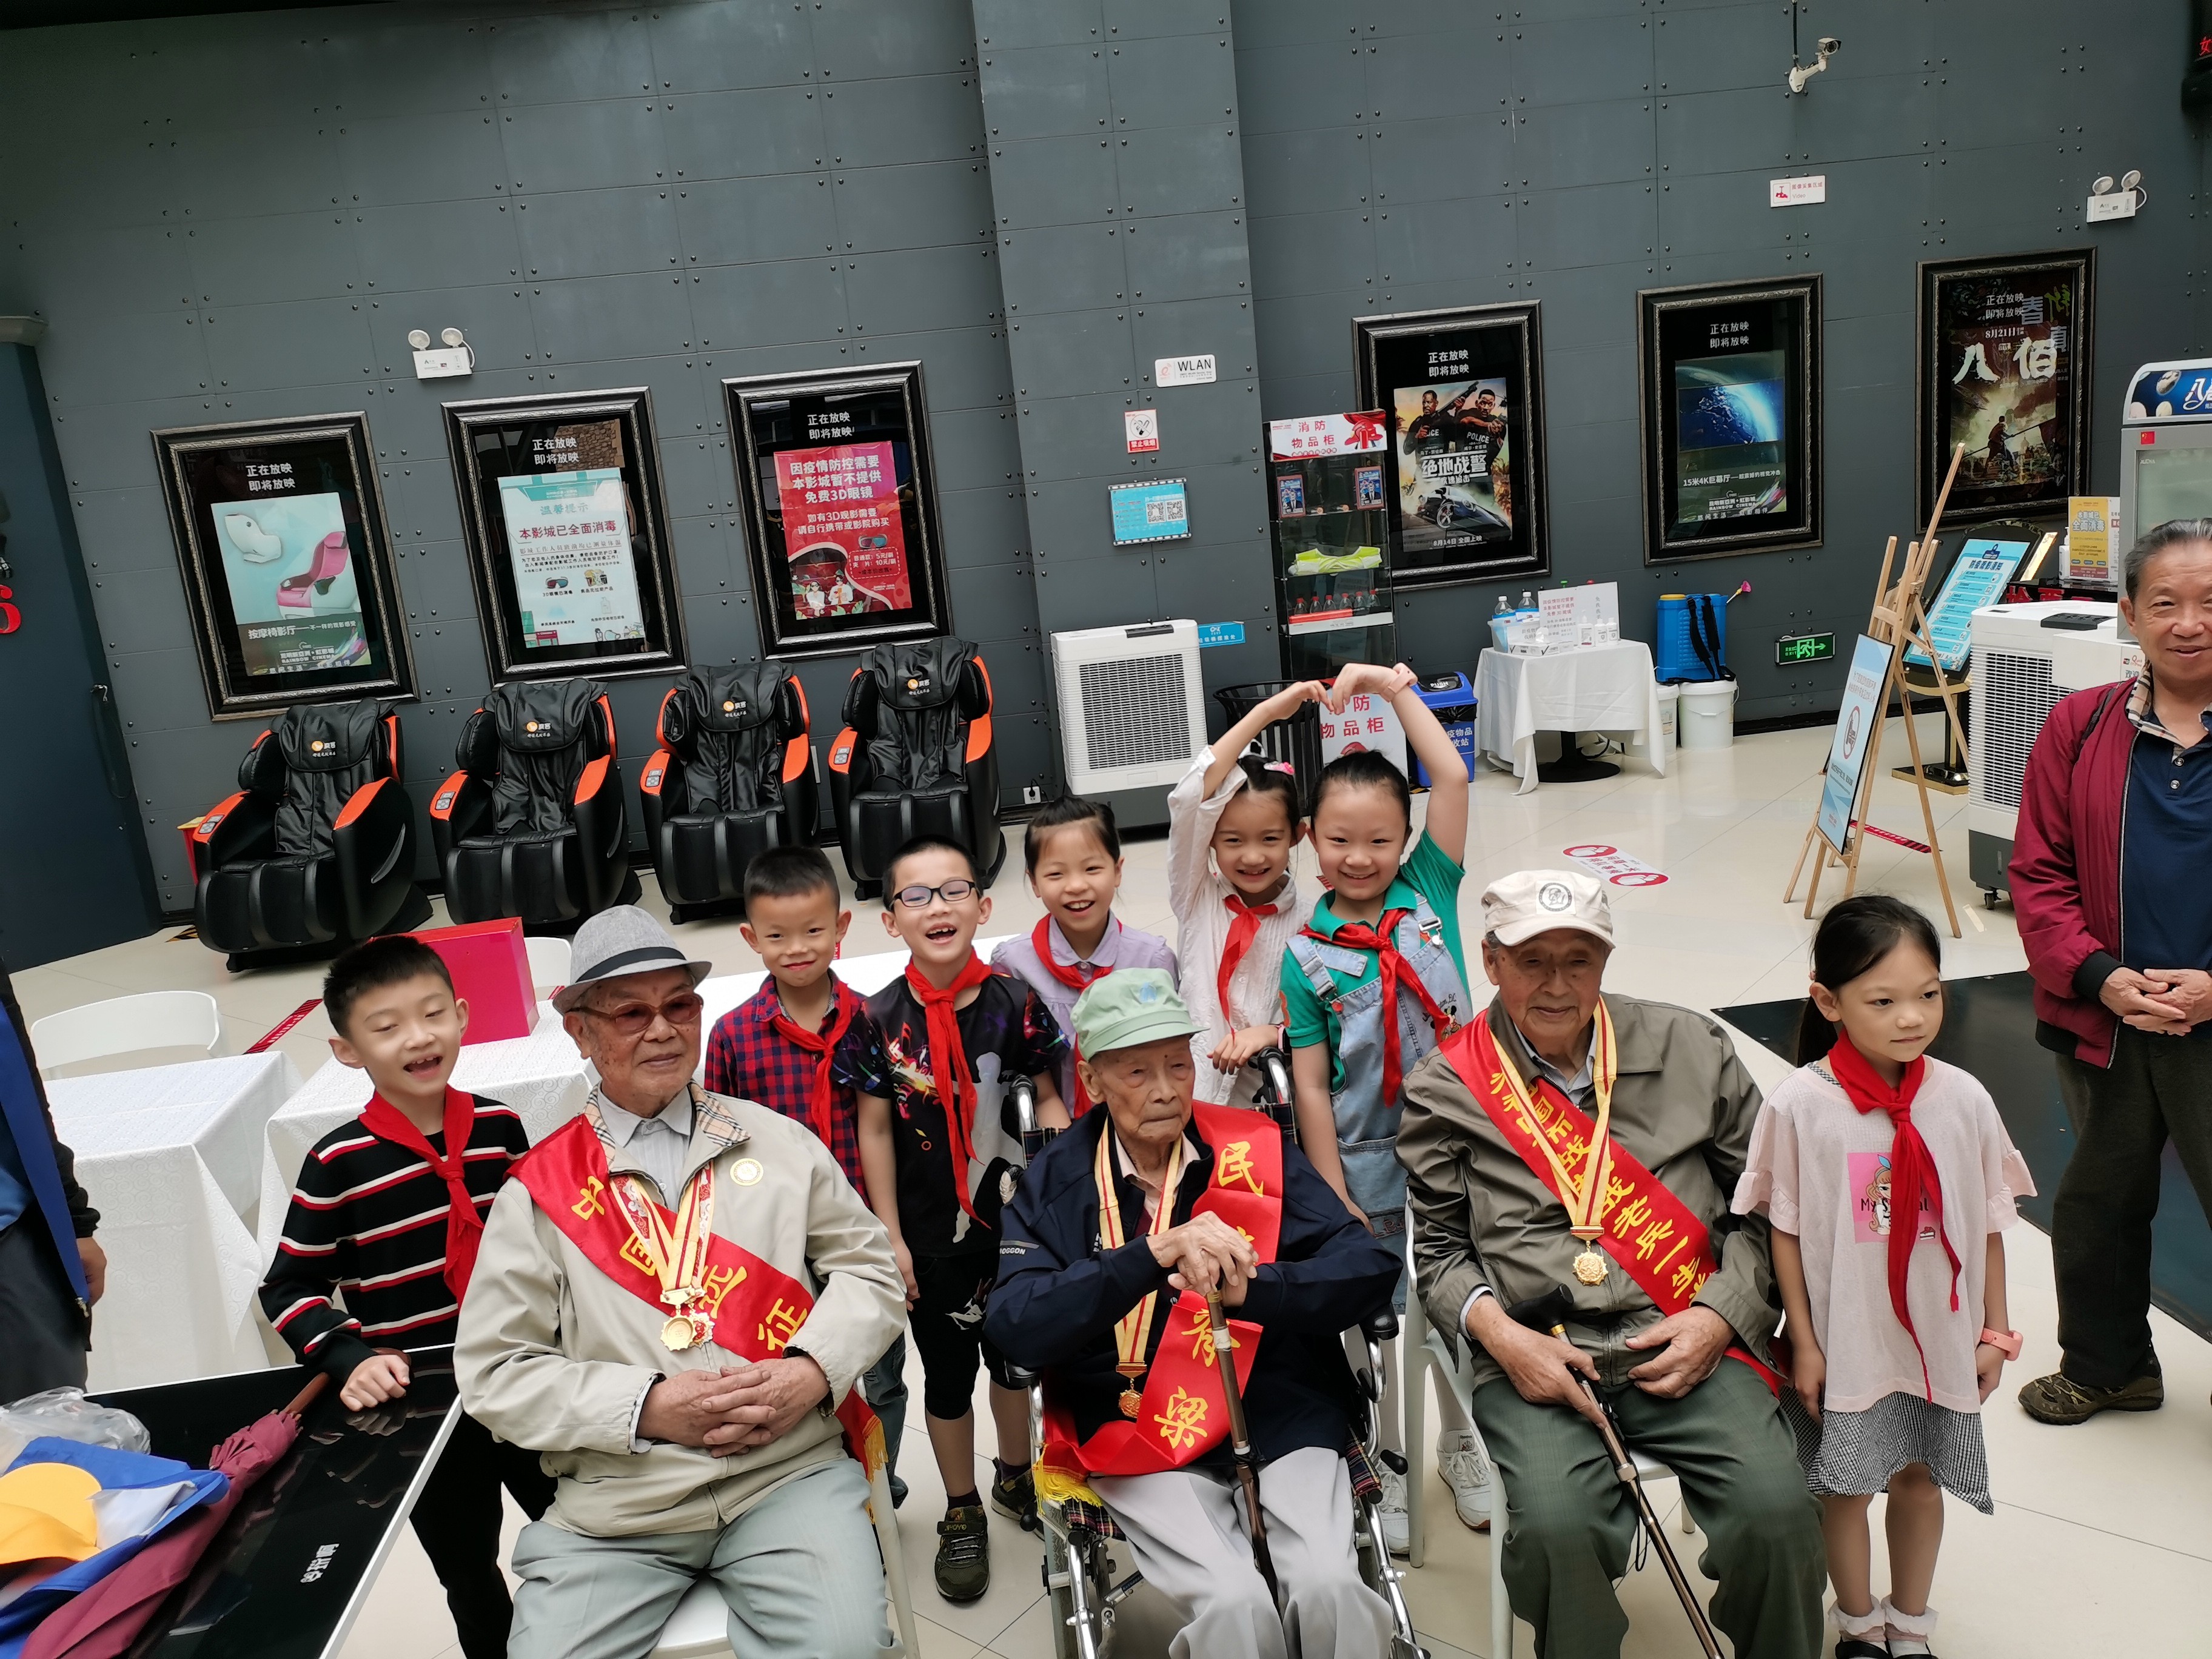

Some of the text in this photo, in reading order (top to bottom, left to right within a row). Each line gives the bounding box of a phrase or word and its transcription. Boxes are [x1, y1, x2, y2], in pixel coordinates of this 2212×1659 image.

[1710, 321, 1749, 335] 正在放映
[1710, 335, 1749, 349] 即将放映
[1428, 349, 1469, 363] 正在放映
[1178, 358, 1211, 371] WLAN
[1429, 364, 1469, 377] 即将放映
[807, 411, 850, 426] 正在放映
[809, 426, 853, 440] 即将放映
[1298, 420, 1326, 433] 消防
[531, 437, 577, 451] 正在放映
[1292, 435, 1335, 449] 物品柜
[1466, 432, 1490, 443] POLICE
[534, 452, 580, 466] 即将放映
[790, 455, 880, 475] 因疫情防控需要
[1421, 455, 1487, 477] 绝地战警
[246, 462, 293, 478] 正在放映
[248, 477, 295, 492] 即将放映
[792, 471, 882, 490] 本影城暂不提供
[805, 487, 874, 504] 免费3D眼镜
[807, 508, 877, 523] 如有3D观影需要
[519, 520, 617, 539] 本影城已全面消毒
[798, 517, 890, 535] 请自行携带或影院购买
[2072, 520, 2106, 532] 全面消毒
[1320, 717, 1384, 739] 物品柜
